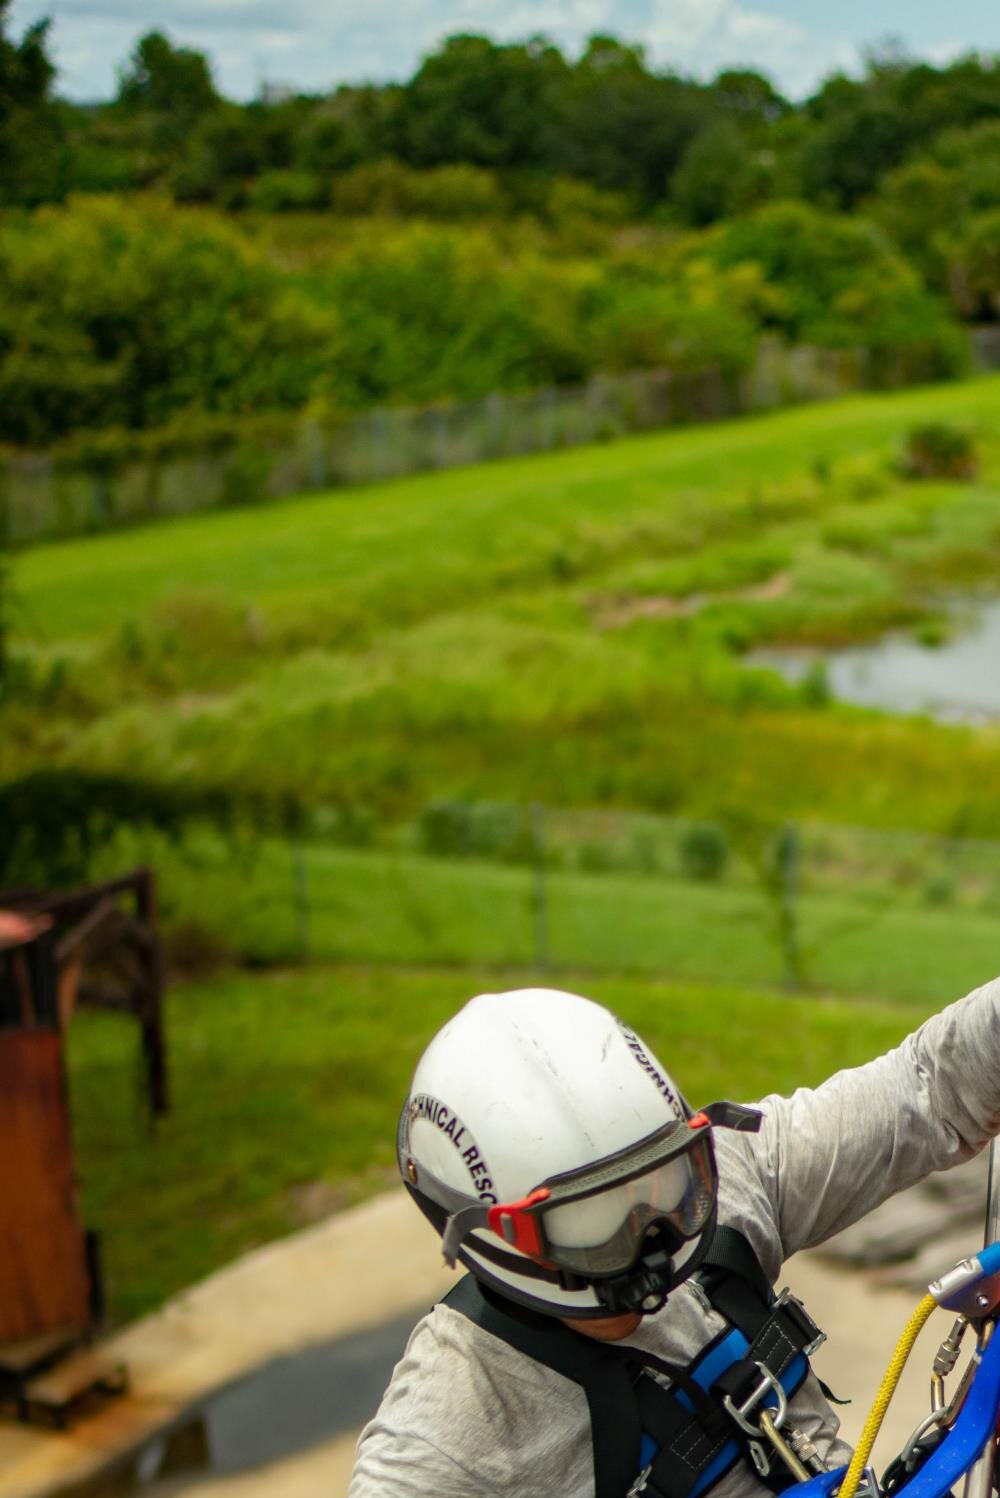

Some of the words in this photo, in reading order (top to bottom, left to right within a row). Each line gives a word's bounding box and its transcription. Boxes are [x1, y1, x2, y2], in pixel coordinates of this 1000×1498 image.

[624, 1032, 684, 1121] CHNICAL
[411, 1096, 465, 1149] CHNICAL
[462, 1145, 498, 1205] RESC
